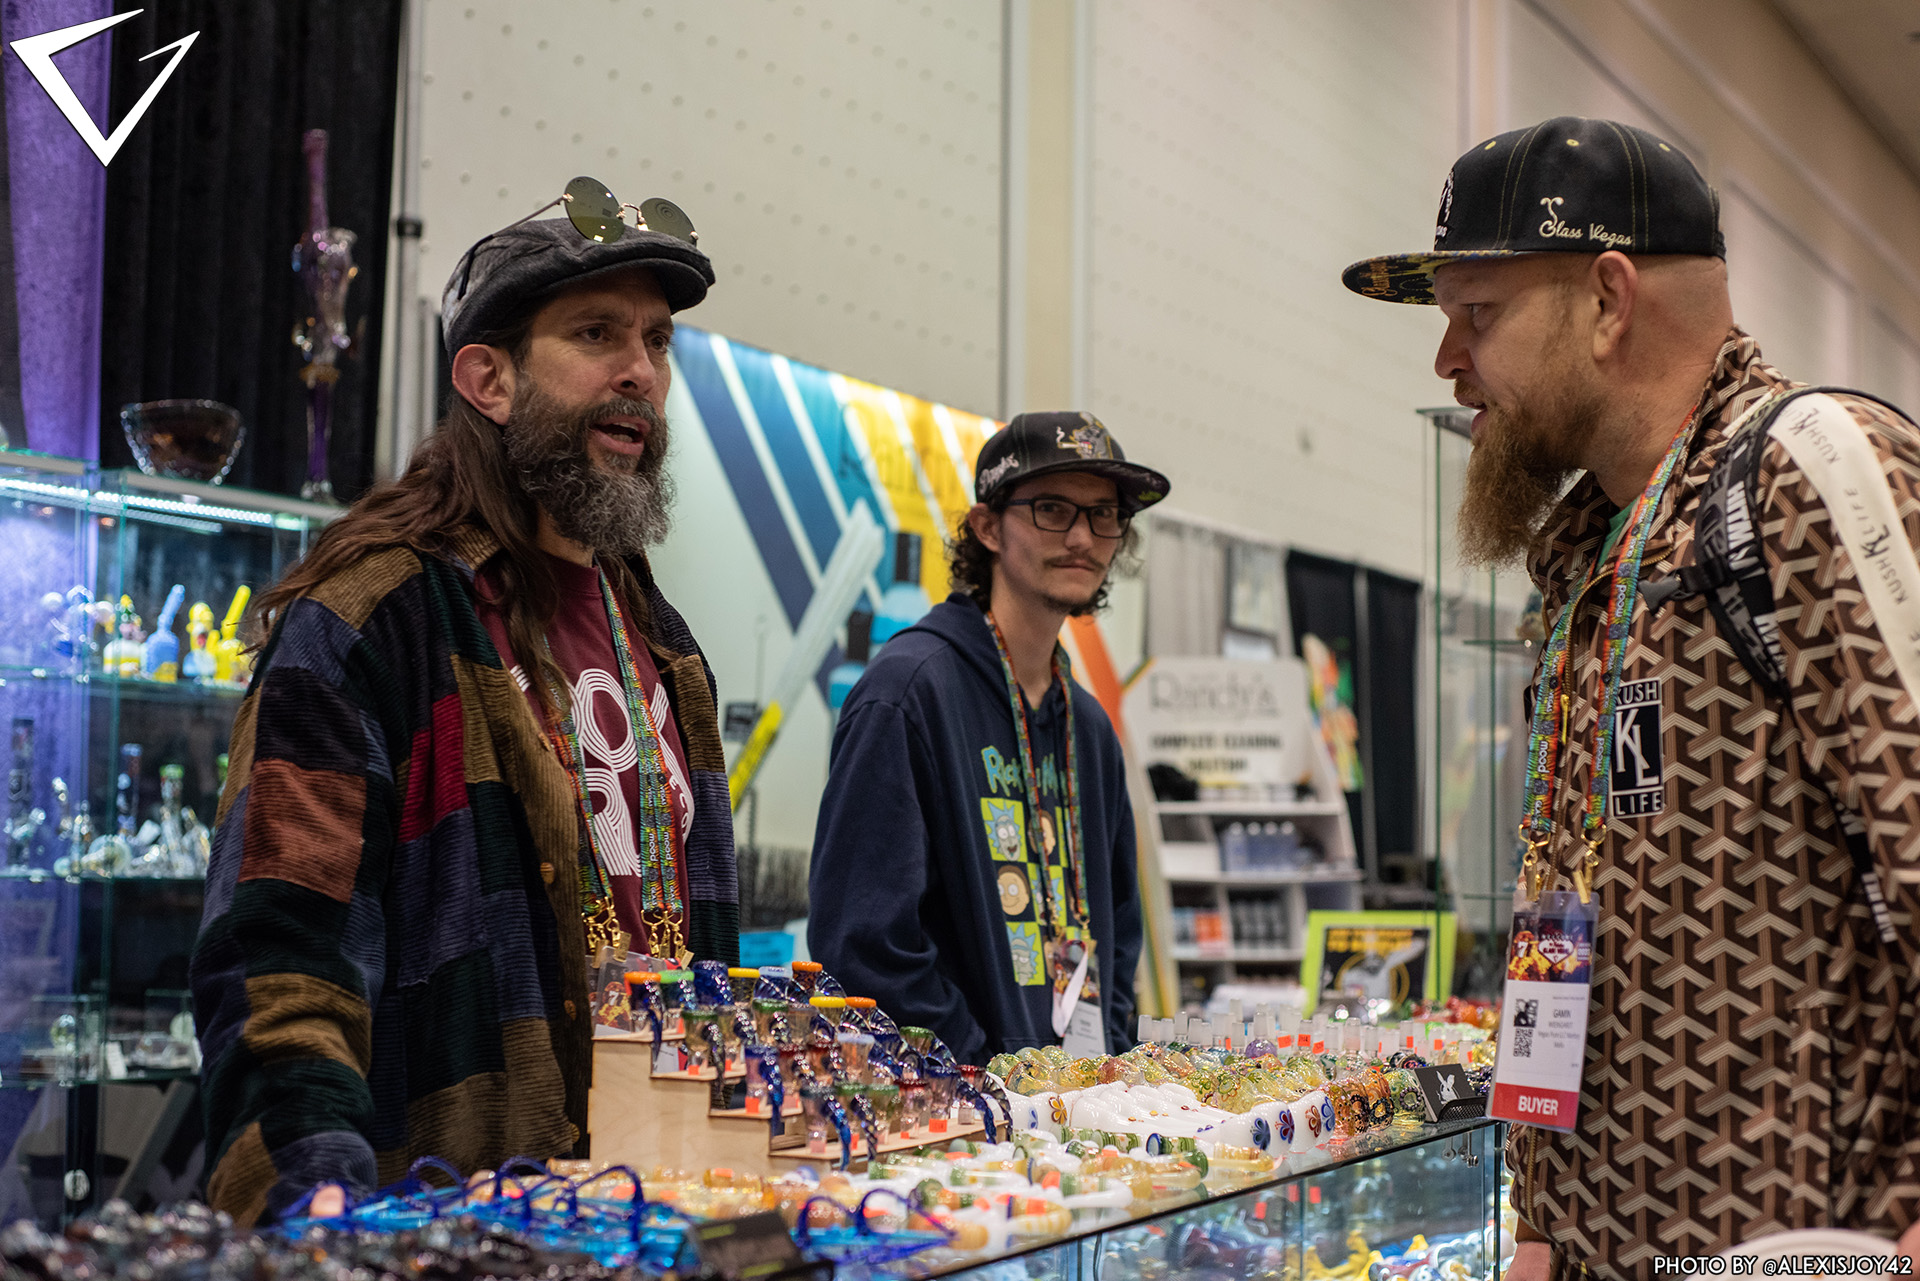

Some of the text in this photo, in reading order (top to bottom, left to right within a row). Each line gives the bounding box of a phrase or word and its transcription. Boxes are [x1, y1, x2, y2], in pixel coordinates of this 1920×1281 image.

[1589, 222, 1633, 249] Vegas
[1806, 426, 1842, 465] KUSH
[1843, 487, 1876, 535] LIFE
[1875, 557, 1909, 605] KUSH
[1615, 584, 1626, 617] mood
[1546, 691, 1555, 713] VEGAS
[640, 704, 655, 732] mood
[1537, 741, 1550, 773] mood
[1595, 737, 1606, 771] mood
[659, 785, 668, 806] VEGAS
[1615, 791, 1662, 816] LIFE
[649, 833, 658, 861] mood
[664, 831, 674, 860] mood
[1517, 941, 1529, 958] 7
[608, 990, 619, 1007] 7
[1517, 1095, 1559, 1117] BUYER
